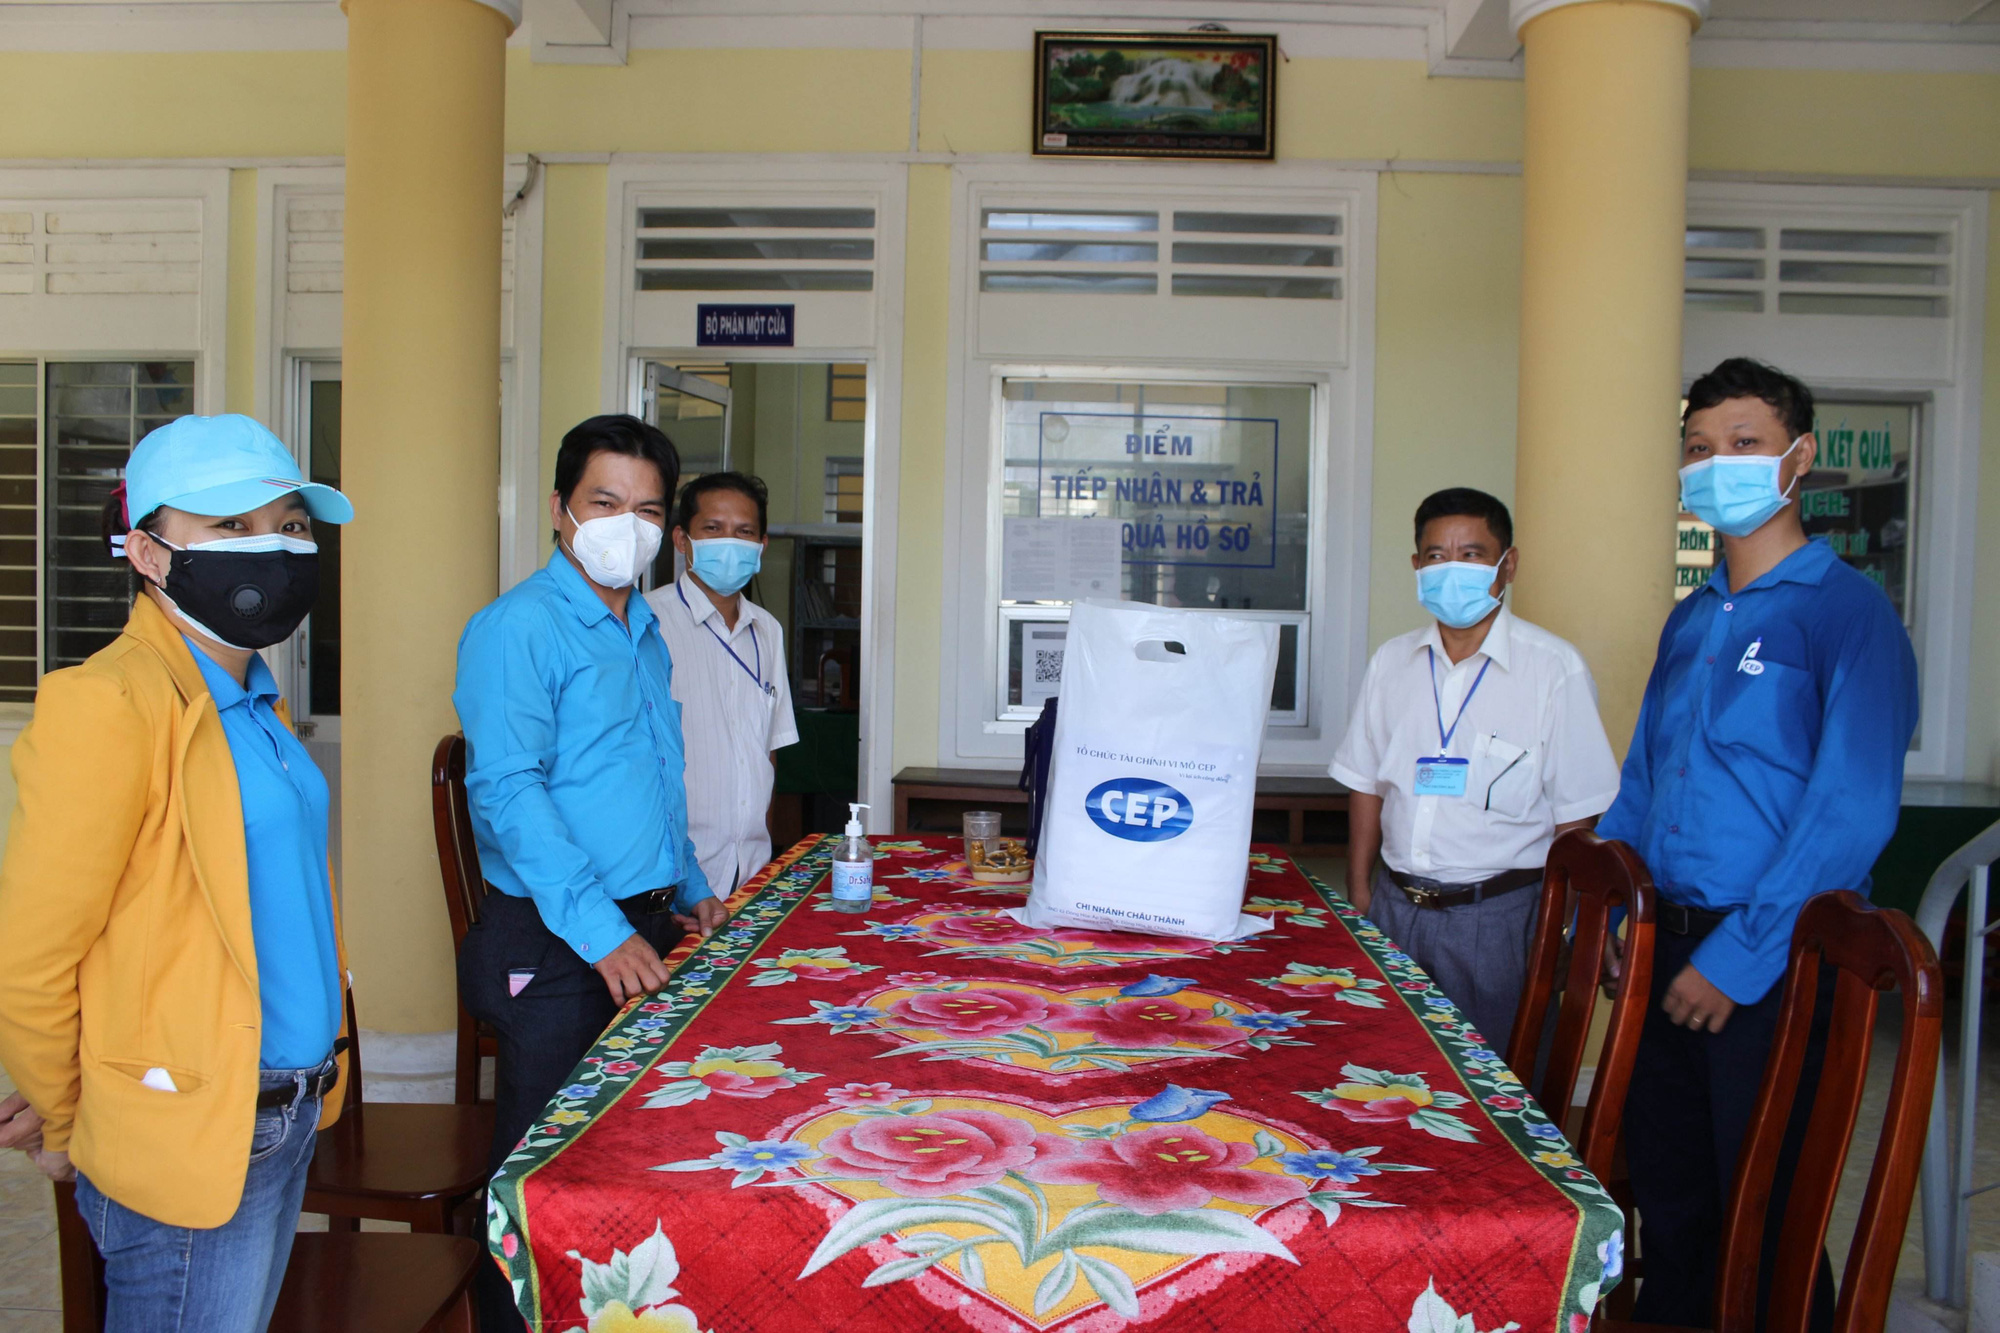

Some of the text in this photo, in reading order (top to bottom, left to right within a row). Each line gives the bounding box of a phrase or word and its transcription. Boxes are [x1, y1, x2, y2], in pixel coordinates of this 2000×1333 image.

[705, 308, 787, 341] BỘ PHẬN MỘT CỬA
[1125, 423, 1193, 456] ĐIỂM
[1859, 421, 1892, 469] QUẢ
[1051, 466, 1264, 508] TIẾP NHẬN & TRẢ
[1121, 514, 1252, 552] QUẢ HỒ SƠ
[1744, 661, 1762, 672] CEP
[1077, 744, 1217, 772] TỔ CHỨC TÀI CHÍNH VI MÔ CEP
[1101, 789, 1179, 828] CEP
[1075, 902, 1090, 911] CHI
[1092, 905, 1125, 917] NHÁNH
[1126, 911, 1152, 921] CHÂU
[1153, 915, 1186, 926] THÀNH
